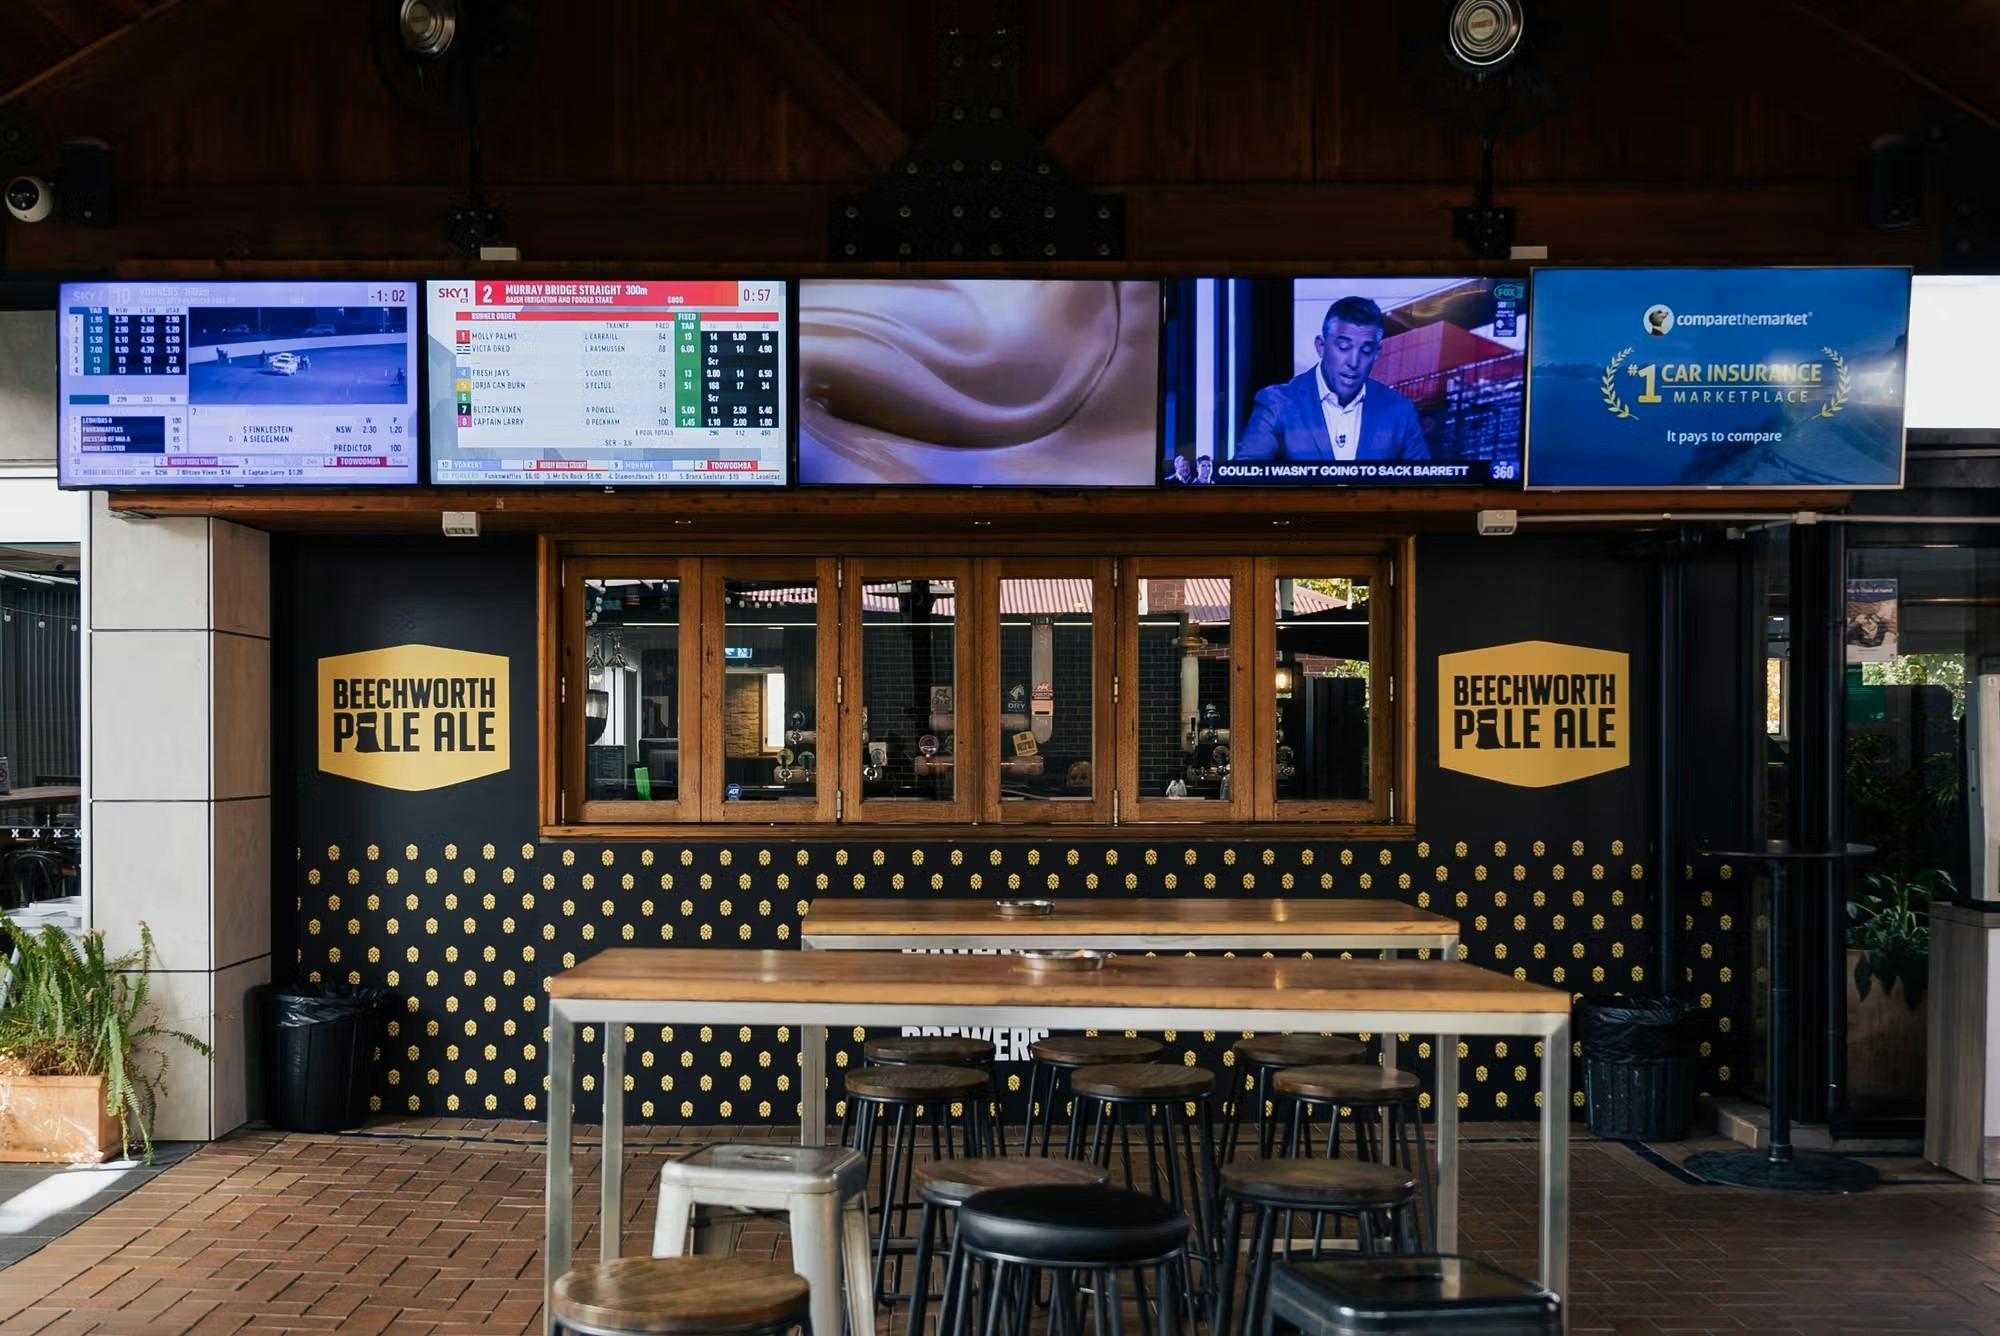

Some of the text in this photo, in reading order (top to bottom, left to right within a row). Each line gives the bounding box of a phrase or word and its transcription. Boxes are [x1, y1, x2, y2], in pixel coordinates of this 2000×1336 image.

[482, 285, 493, 303] 2
[506, 285, 648, 295] MURRAY BRIDGE STRAIGHT 300m
[743, 289, 770, 302] 0:57
[667, 296, 684, 304] GOOD
[710, 333, 718, 341] 14
[736, 345, 744, 353] 14
[169, 356, 177, 364] 22
[708, 357, 719, 366] Scr
[144, 366, 152, 374] 11
[1661, 364, 1822, 382] CAR INSURANCE
[736, 382, 744, 390] 17
[761, 382, 770, 390] 34
[1627, 364, 1662, 404] #1
[708, 394, 719, 402] Scr
[1673, 390, 1809, 404] MARKETPLACE
[1667, 430, 1782, 445] It pays to compare
[1218, 466, 1469, 476] GOULD: I WASN'T GOING TO SACK BARRETT
[1492, 465, 1514, 479] 360
[333, 677, 496, 709] BEECHWORTH
[1454, 674, 1616, 706] BEECHWORTH
[434, 712, 496, 752] ALE
[1554, 708, 1616, 748] ALE
